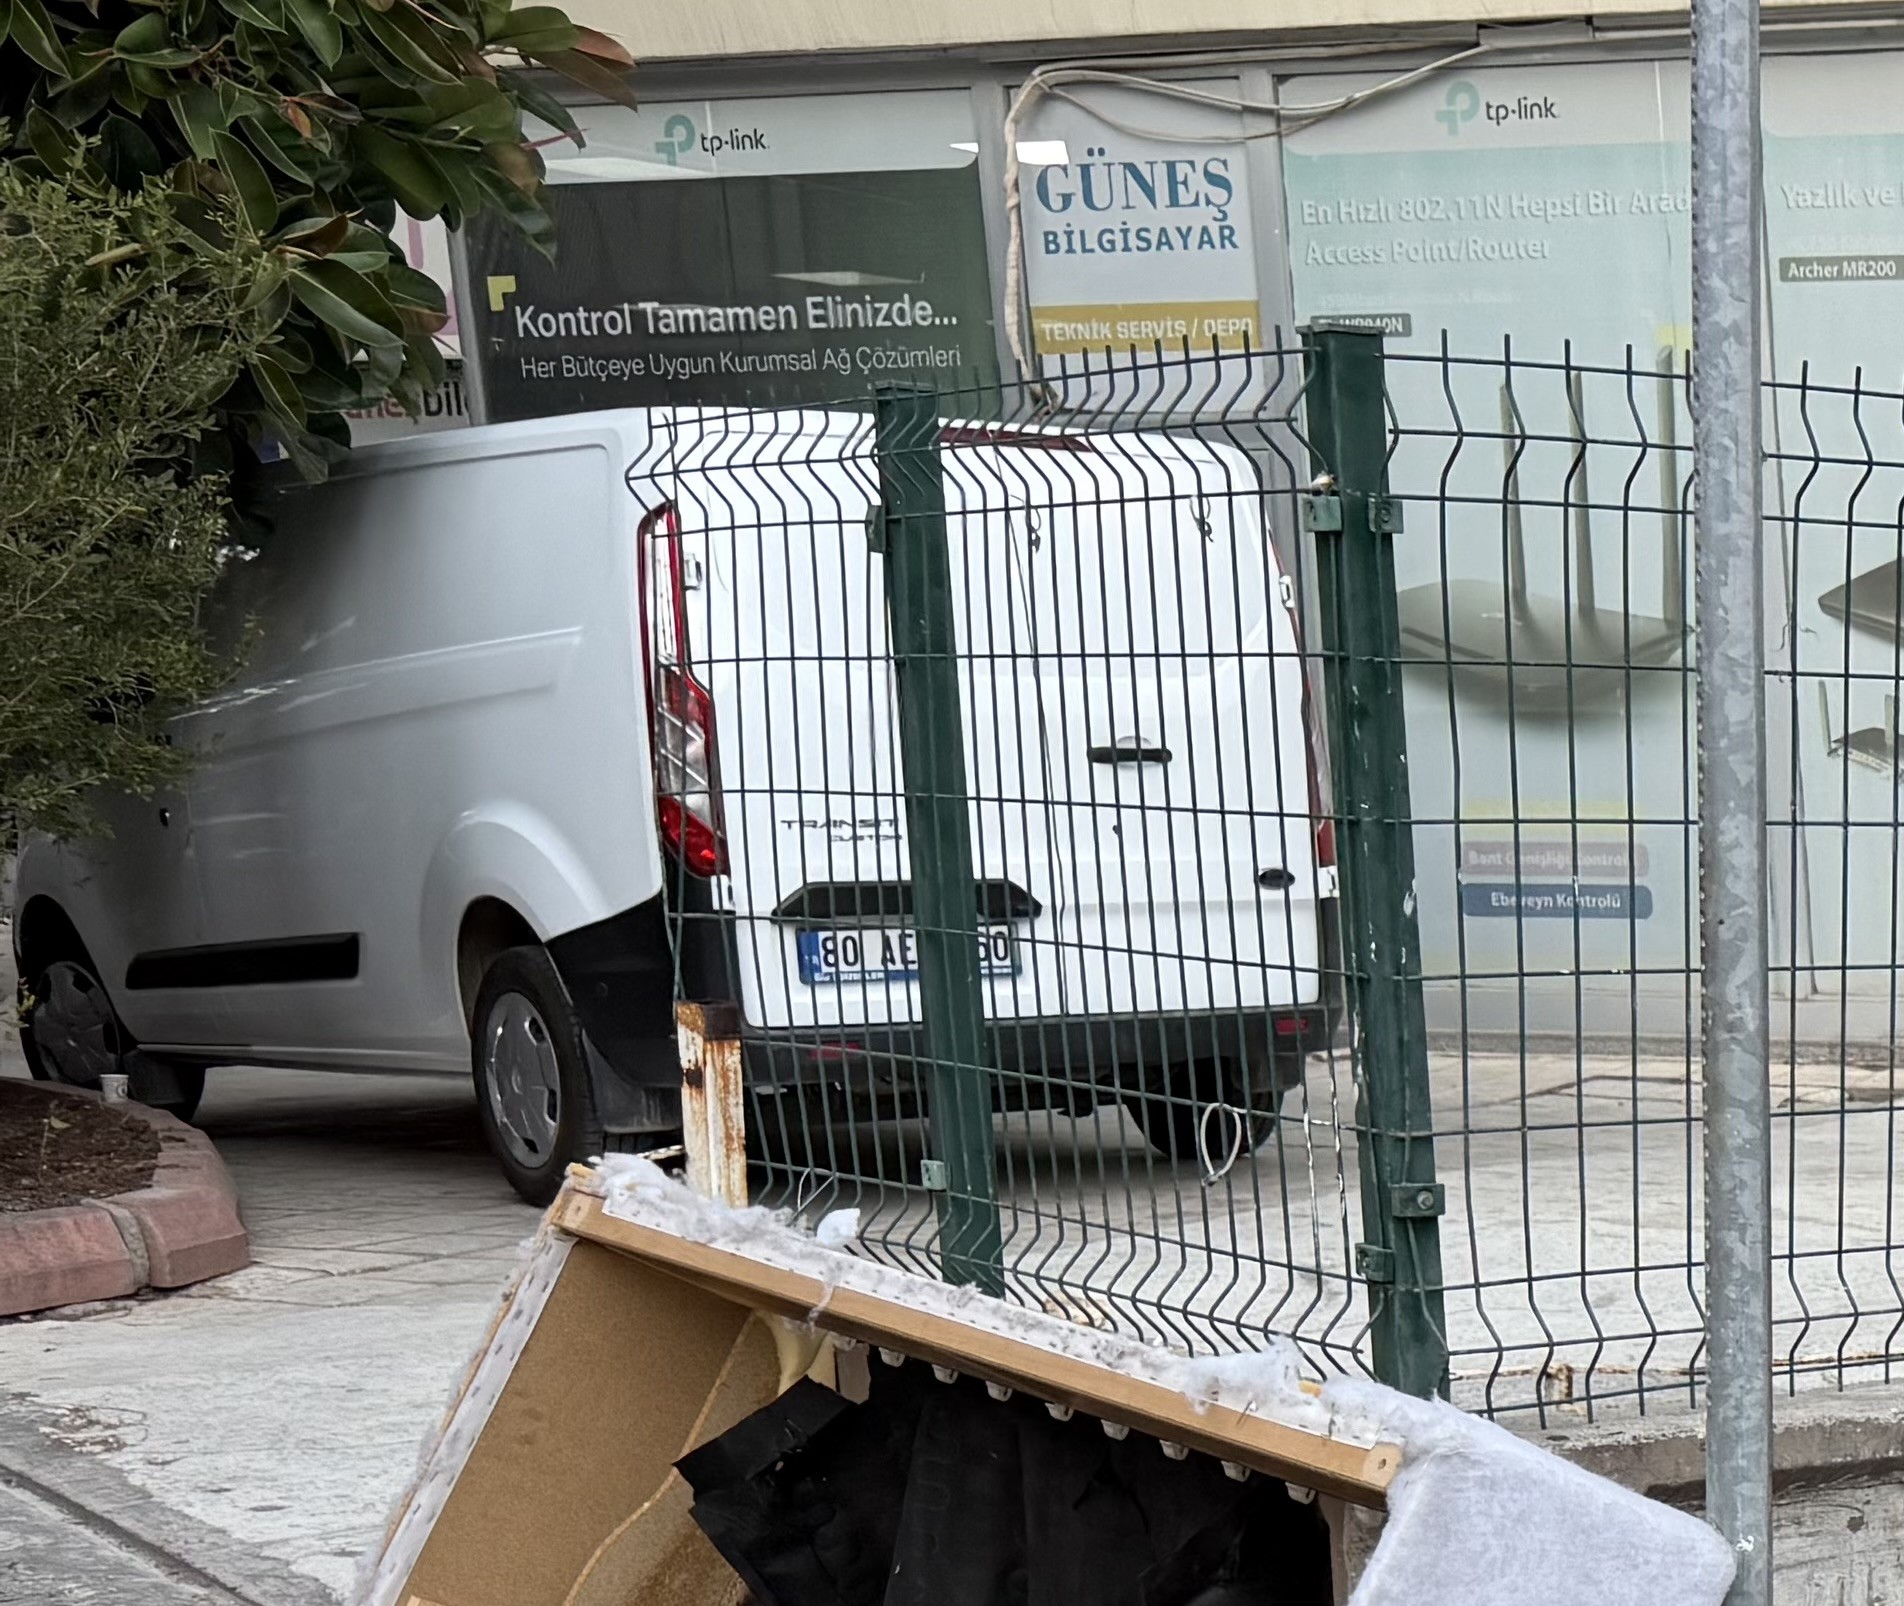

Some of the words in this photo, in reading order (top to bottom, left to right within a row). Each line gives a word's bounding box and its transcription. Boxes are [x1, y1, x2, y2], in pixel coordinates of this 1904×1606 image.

[1036, 147, 1233, 222] GÜNEŞ
[1781, 182, 1856, 209] Yazlık
[1863, 186, 1892, 207] ve
[1302, 202, 1332, 225] En
[1337, 200, 1391, 224] Hızlı
[1510, 193, 1579, 223] Hepsi
[1587, 193, 1621, 216] Bir
[1630, 192, 1691, 216] Arad
[1043, 221, 1239, 254] BİLGİSAYAR
[1305, 240, 1386, 266] Access
[1391, 237, 1551, 265] Point/Router
[1788, 261, 1838, 279] Archer
[1843, 260, 1896, 277] MR200
[515, 303, 632, 337] Kontrol
[639, 300, 797, 335] Tamamen
[805, 295, 957, 330] Elinizde...
[1040, 318, 1110, 341] TEKNİK
[1117, 317, 1186, 340] SERVİS
[521, 357, 555, 379] Her
[563, 354, 643, 381] Bütçeye
[649, 353, 714, 380] Uygun
[720, 348, 816, 375] Kurumsal
[822, 346, 850, 375] Ağ
[856, 345, 960, 374] Çözümleri
